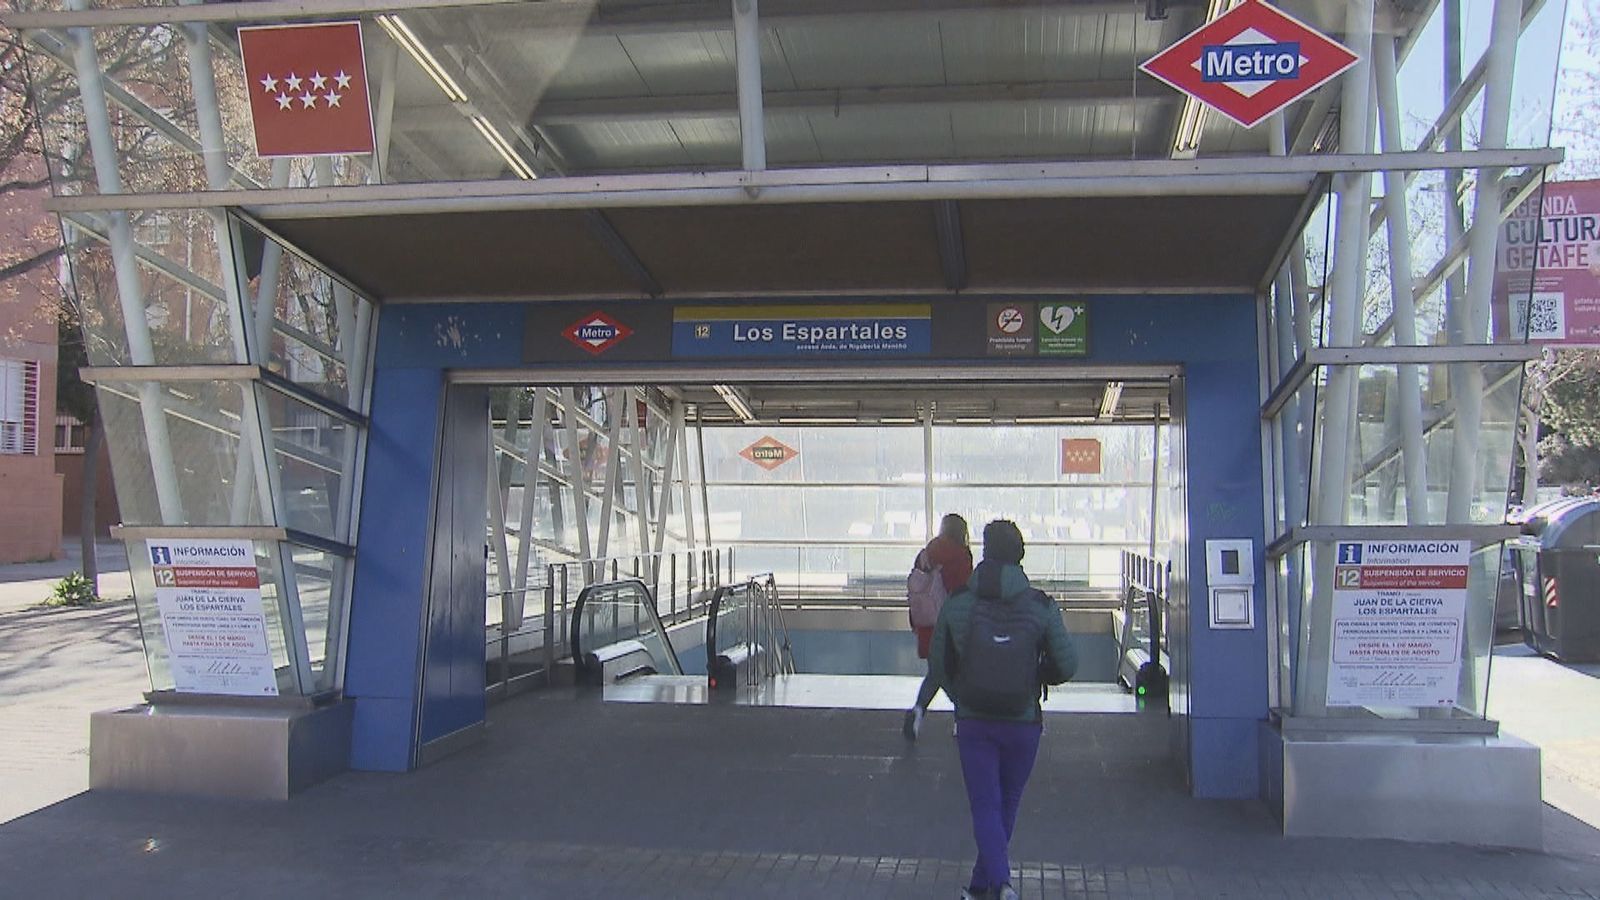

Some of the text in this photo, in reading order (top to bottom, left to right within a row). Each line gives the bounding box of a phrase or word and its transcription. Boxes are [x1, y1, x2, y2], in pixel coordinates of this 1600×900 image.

[1207, 50, 1294, 76] Metro
[1505, 217, 1600, 244] CULTUR
[1506, 243, 1589, 269] GETAFE
[582, 328, 612, 338] Metro
[696, 325, 709, 337] 12
[734, 323, 907, 343] Los Espartales
[173, 546, 246, 556] INFORMACIÓN
[1368, 543, 1459, 553] INFORMACIÓN
[155, 570, 174, 585] 12
[176, 569, 216, 577] SUSPENSIÓN
[227, 570, 256, 578] SERVICIO
[1339, 570, 1360, 586] 12
[1363, 569, 1412, 577] SUSPENSIÓN
